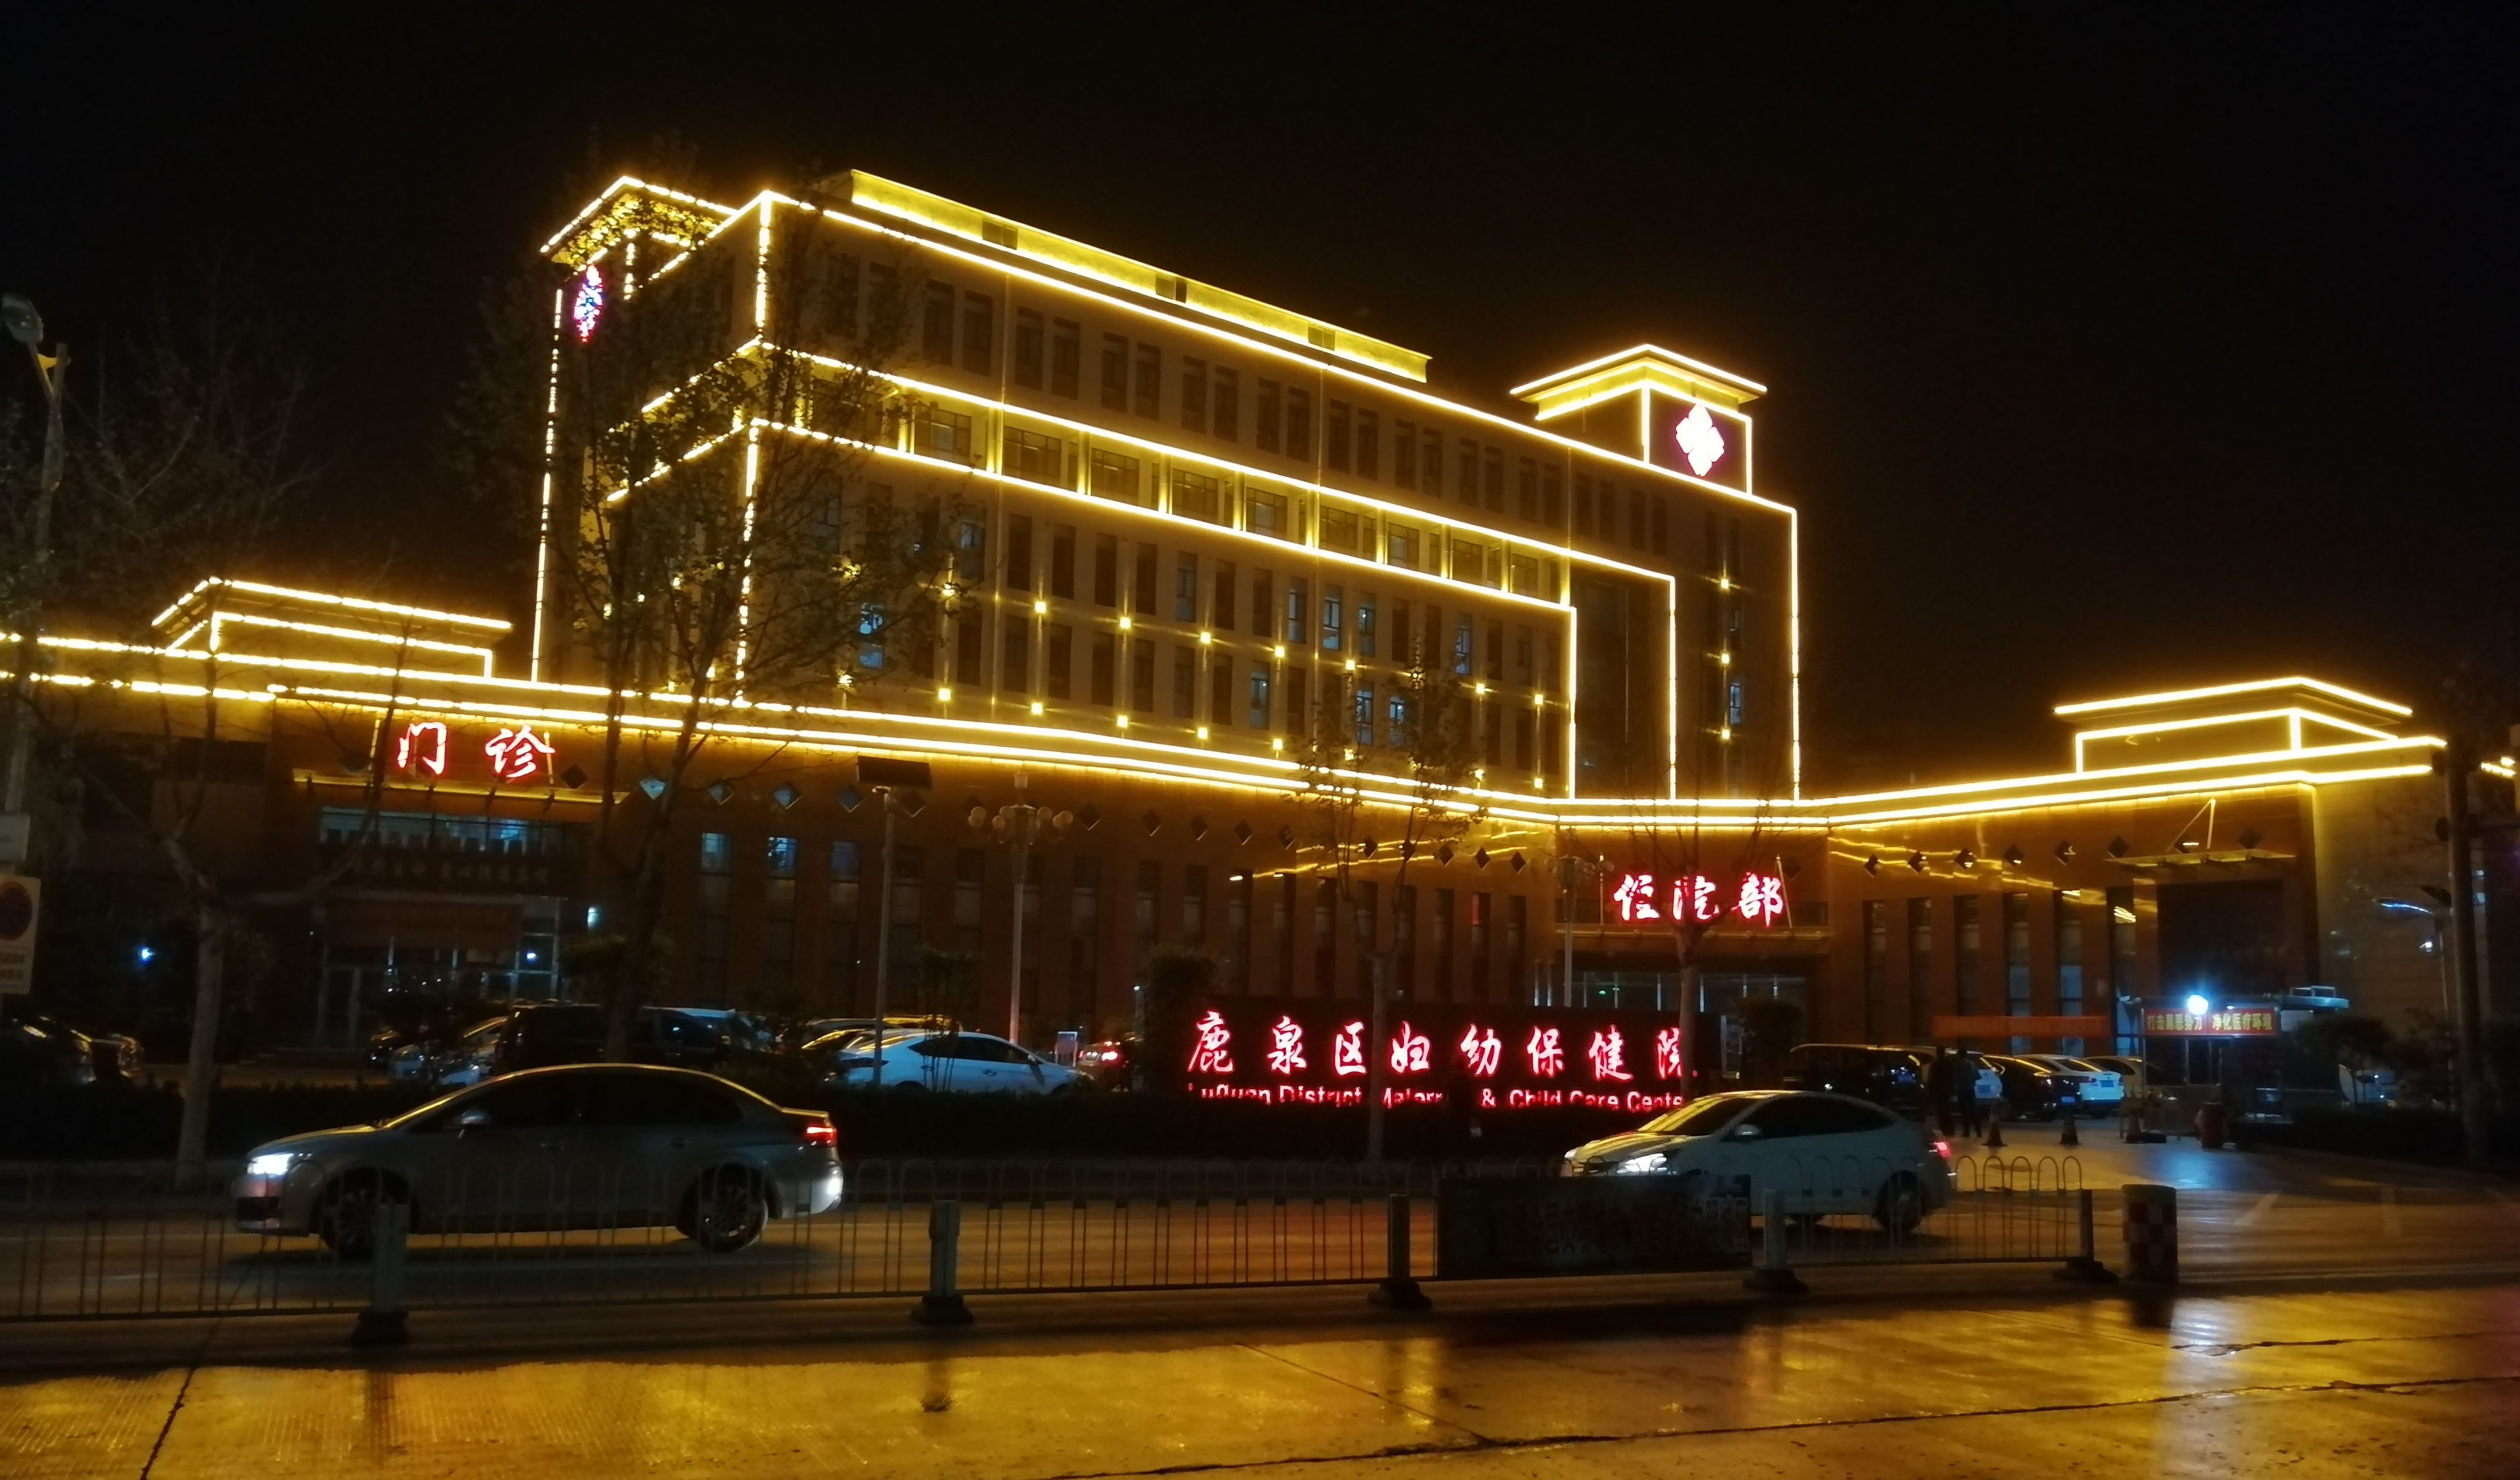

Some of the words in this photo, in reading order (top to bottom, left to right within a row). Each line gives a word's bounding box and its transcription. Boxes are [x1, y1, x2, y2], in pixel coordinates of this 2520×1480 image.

[397, 722, 556, 778] 门诊
[1613, 873, 1784, 927] 住院部
[1482, 1088, 1496, 1107] &
